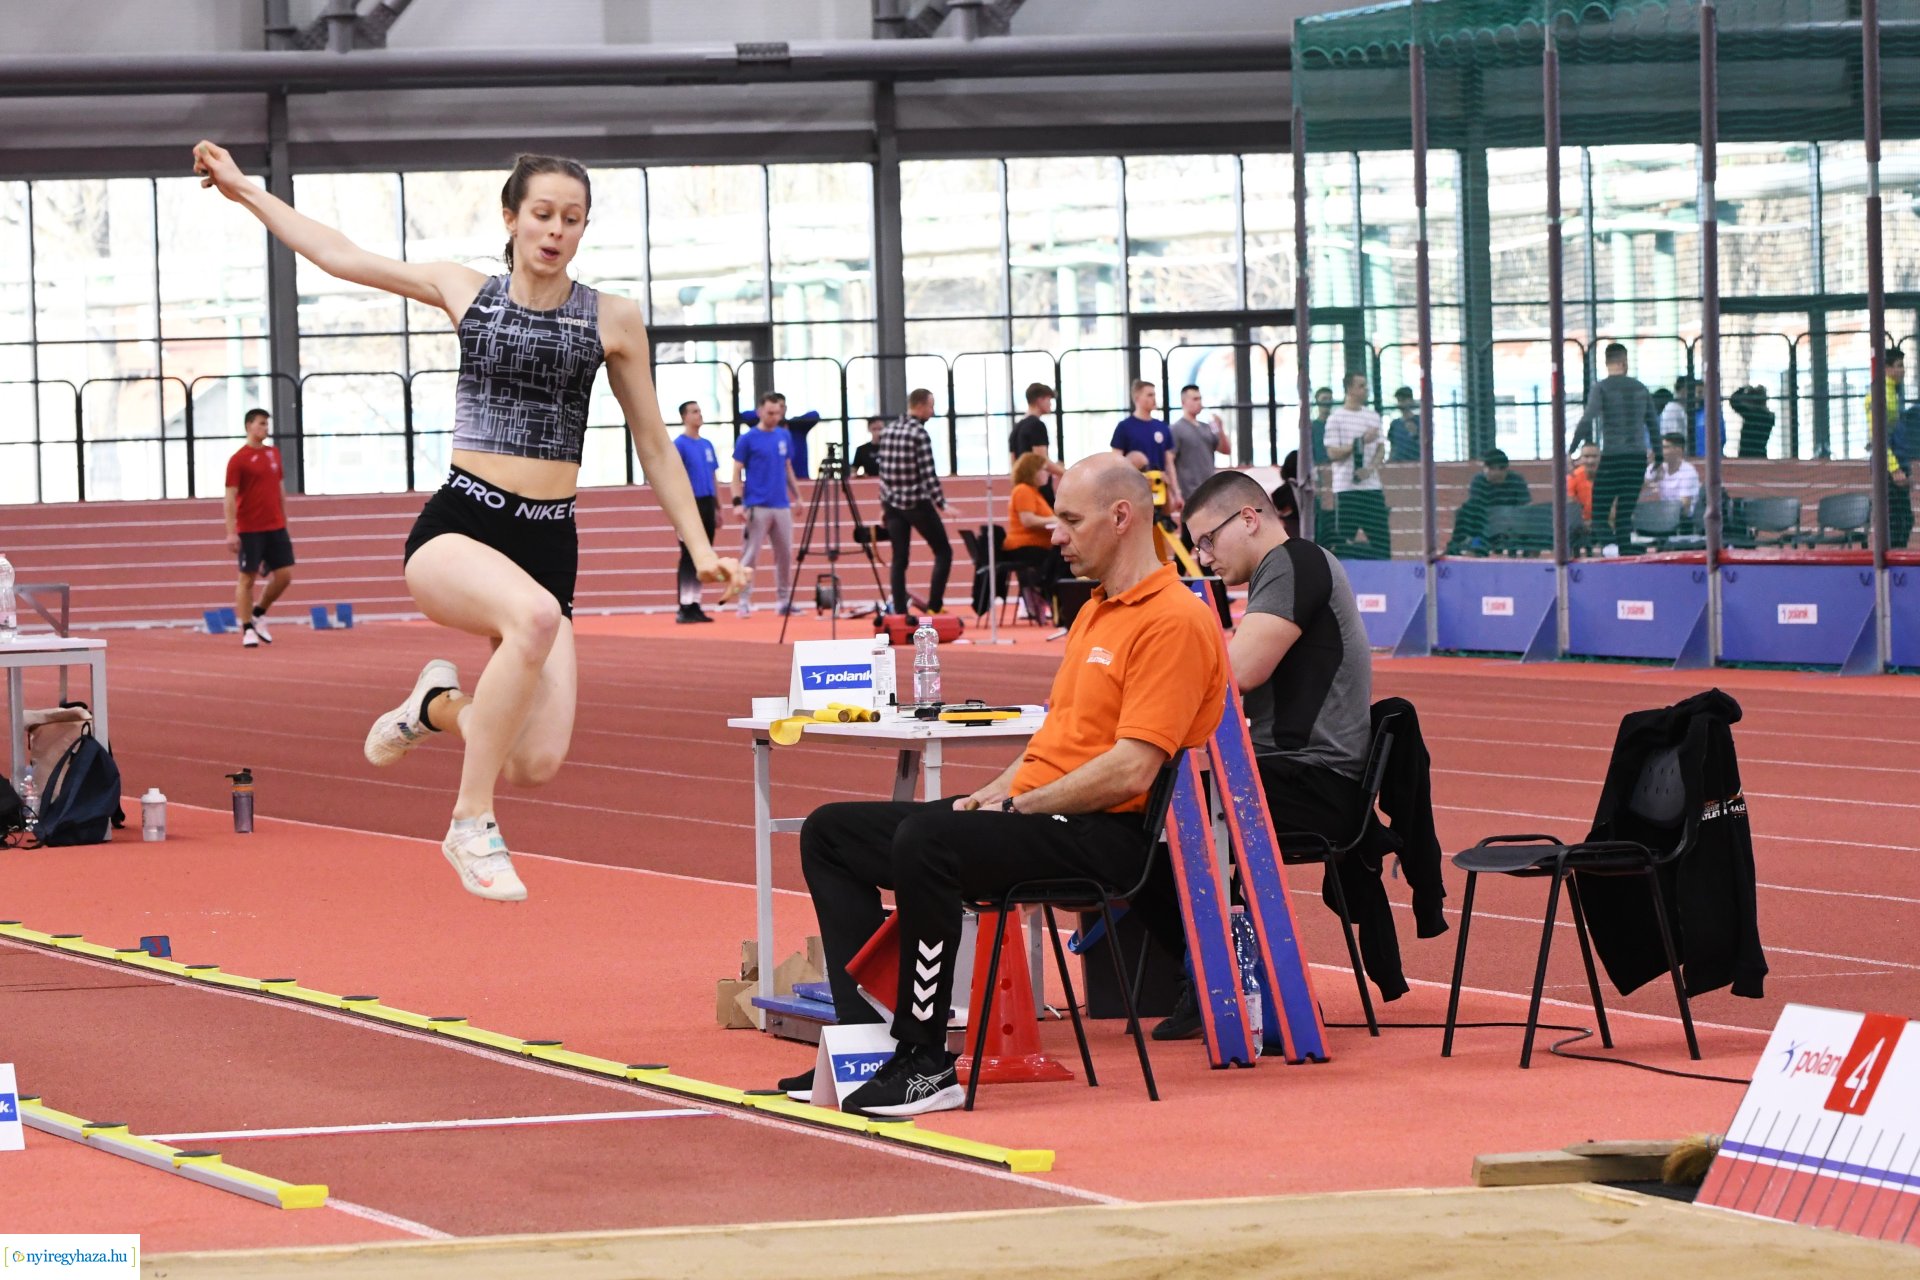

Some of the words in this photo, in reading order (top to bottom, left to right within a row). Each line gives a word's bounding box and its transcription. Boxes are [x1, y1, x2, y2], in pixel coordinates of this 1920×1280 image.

[451, 474, 506, 509] PRO
[514, 502, 568, 520] NIKE
[825, 669, 873, 685] polanik
[1789, 1046, 1843, 1079] polan
[1843, 1036, 1886, 1109] 4
